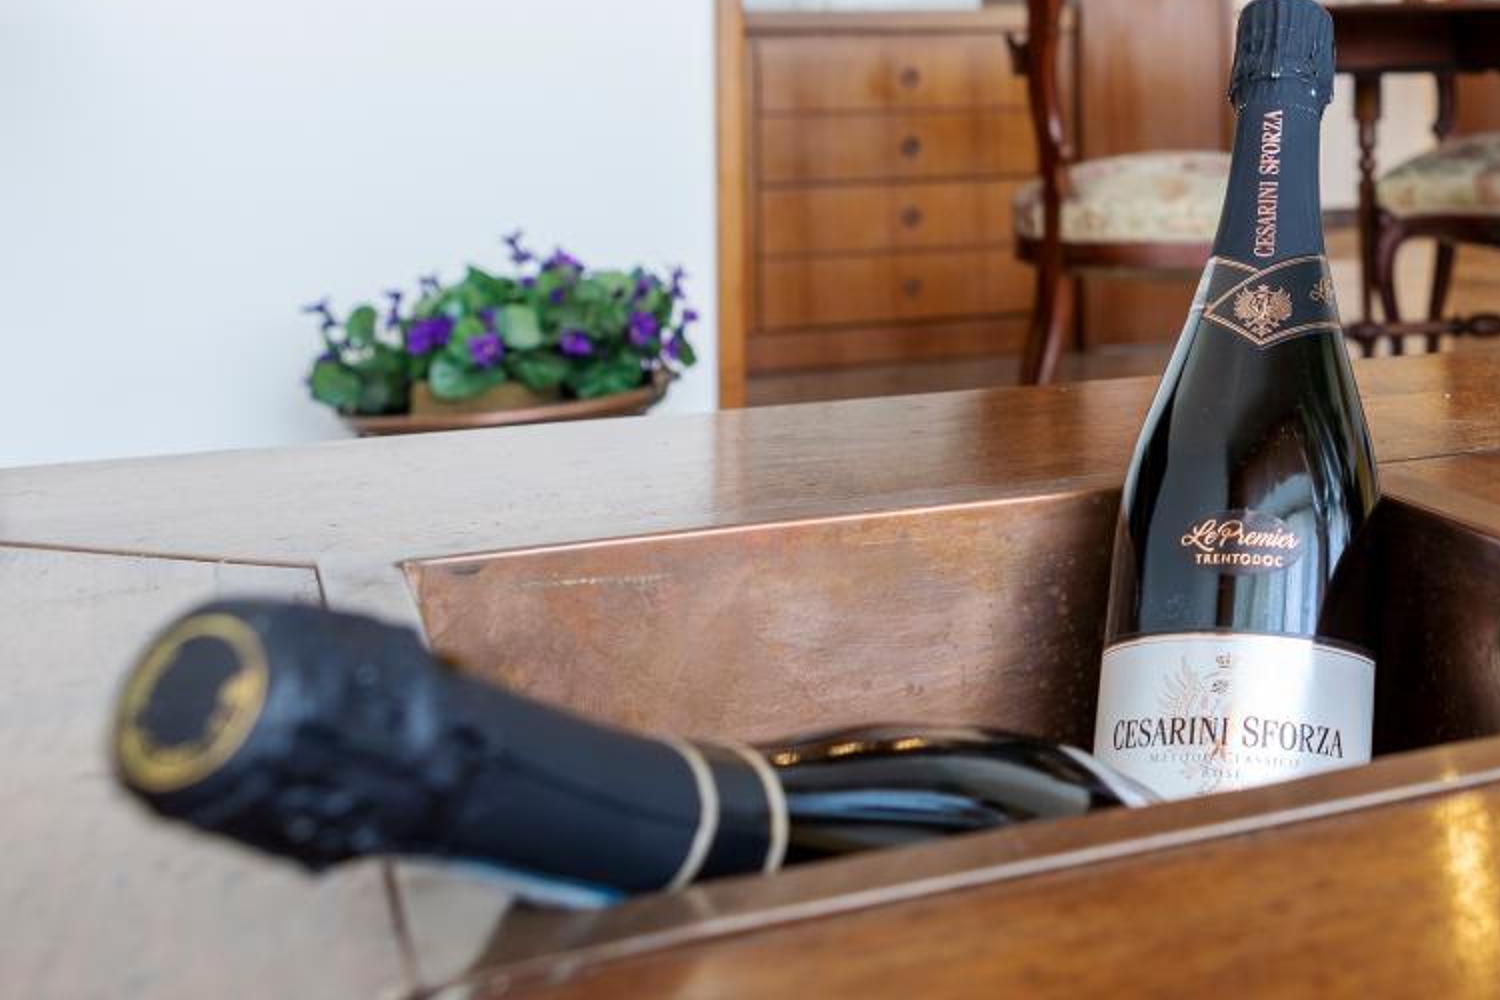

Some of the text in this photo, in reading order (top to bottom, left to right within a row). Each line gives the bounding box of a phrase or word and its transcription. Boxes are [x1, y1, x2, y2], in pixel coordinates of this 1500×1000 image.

[1254, 110, 1283, 258] CESARINI SFORZA
[1181, 519, 1298, 551] Le Premier
[1195, 553, 1283, 567] TRENTODOC
[1113, 715, 1344, 758] CESARINI SFORZA
